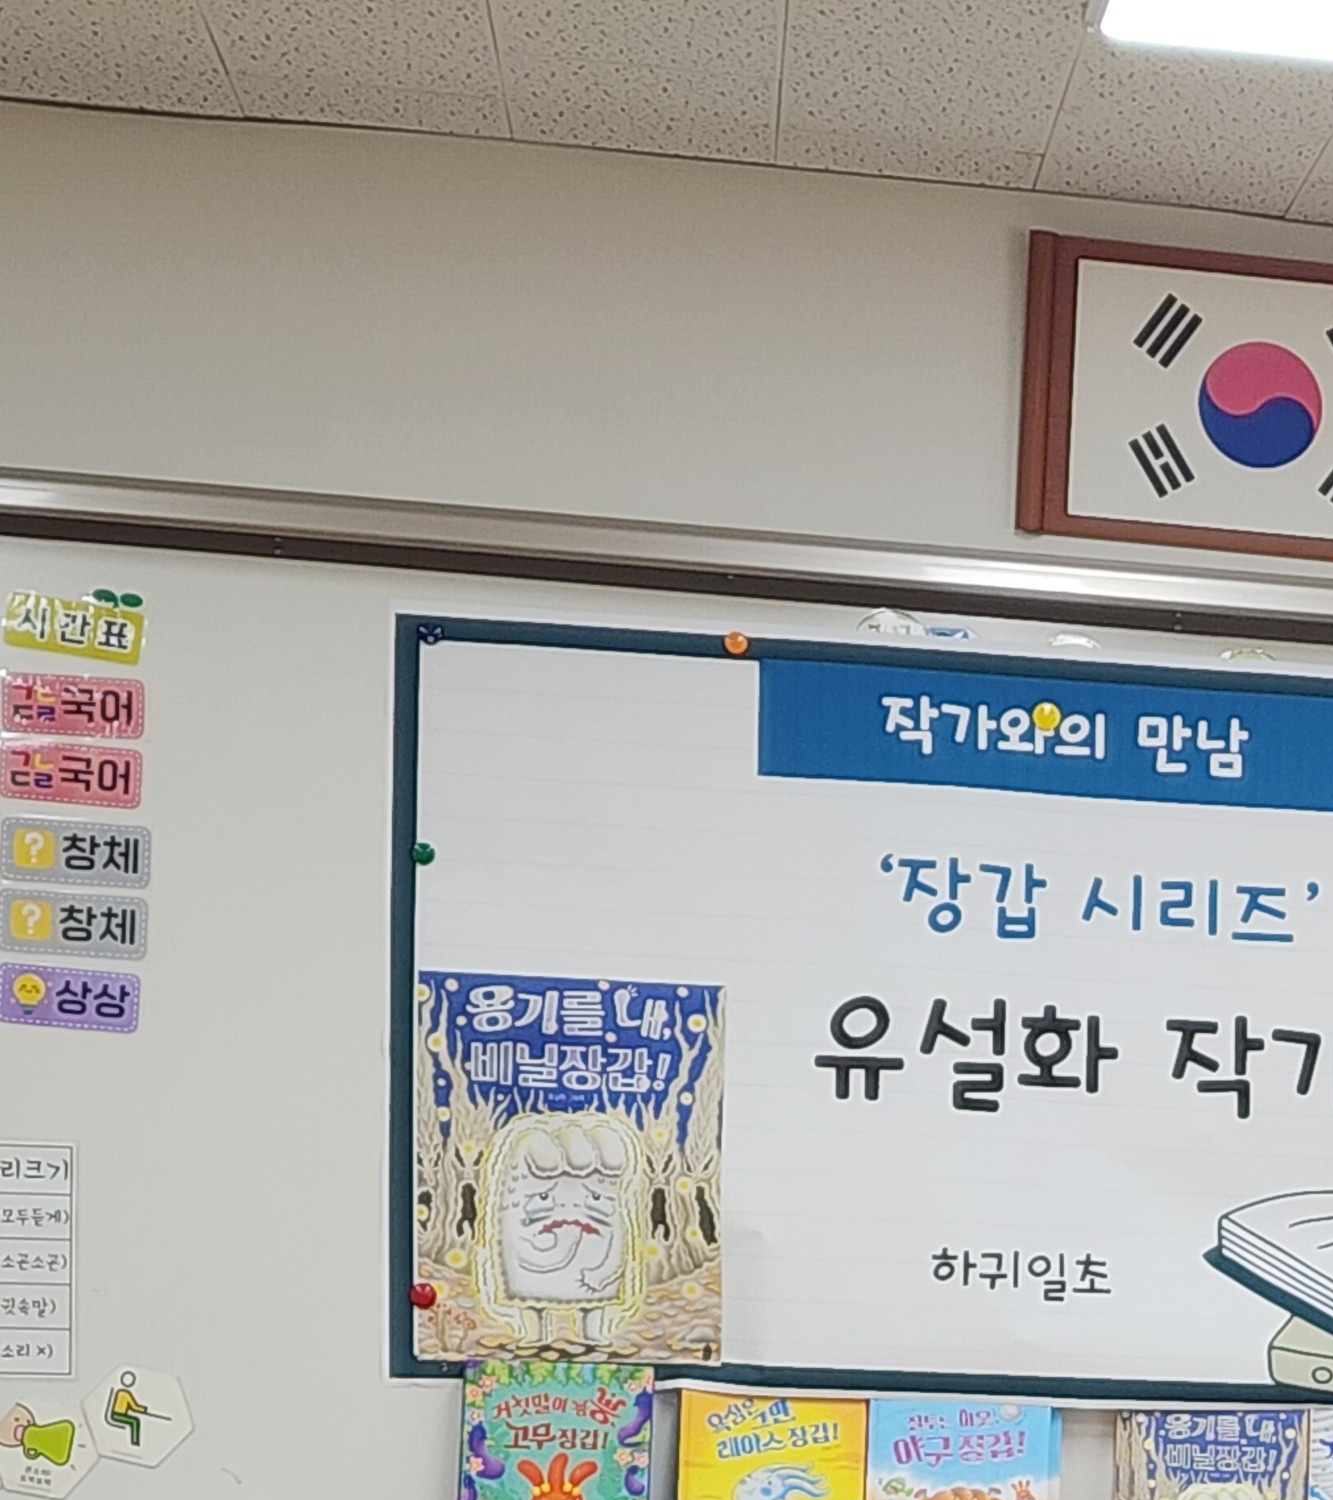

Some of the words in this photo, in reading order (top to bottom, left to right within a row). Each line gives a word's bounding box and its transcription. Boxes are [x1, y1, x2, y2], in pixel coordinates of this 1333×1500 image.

[17, 606, 130, 651] 시간표
[61, 686, 134, 726] 국어
[881, 695, 1105, 759] 작가와의
[1137, 714, 1249, 778] 만남
[58, 755, 131, 796] 국어
[61, 833, 140, 875] 창체
[58, 904, 136, 946] 창체
[55, 979, 131, 1019] 상상
[466, 985, 605, 1036] 용기를
[613, 989, 672, 1040] 내,
[814, 995, 1118, 1112] 유설화
[930, 1246, 1113, 1302] 하귀일초
[1165, 1414, 1240, 1441] 용기를
